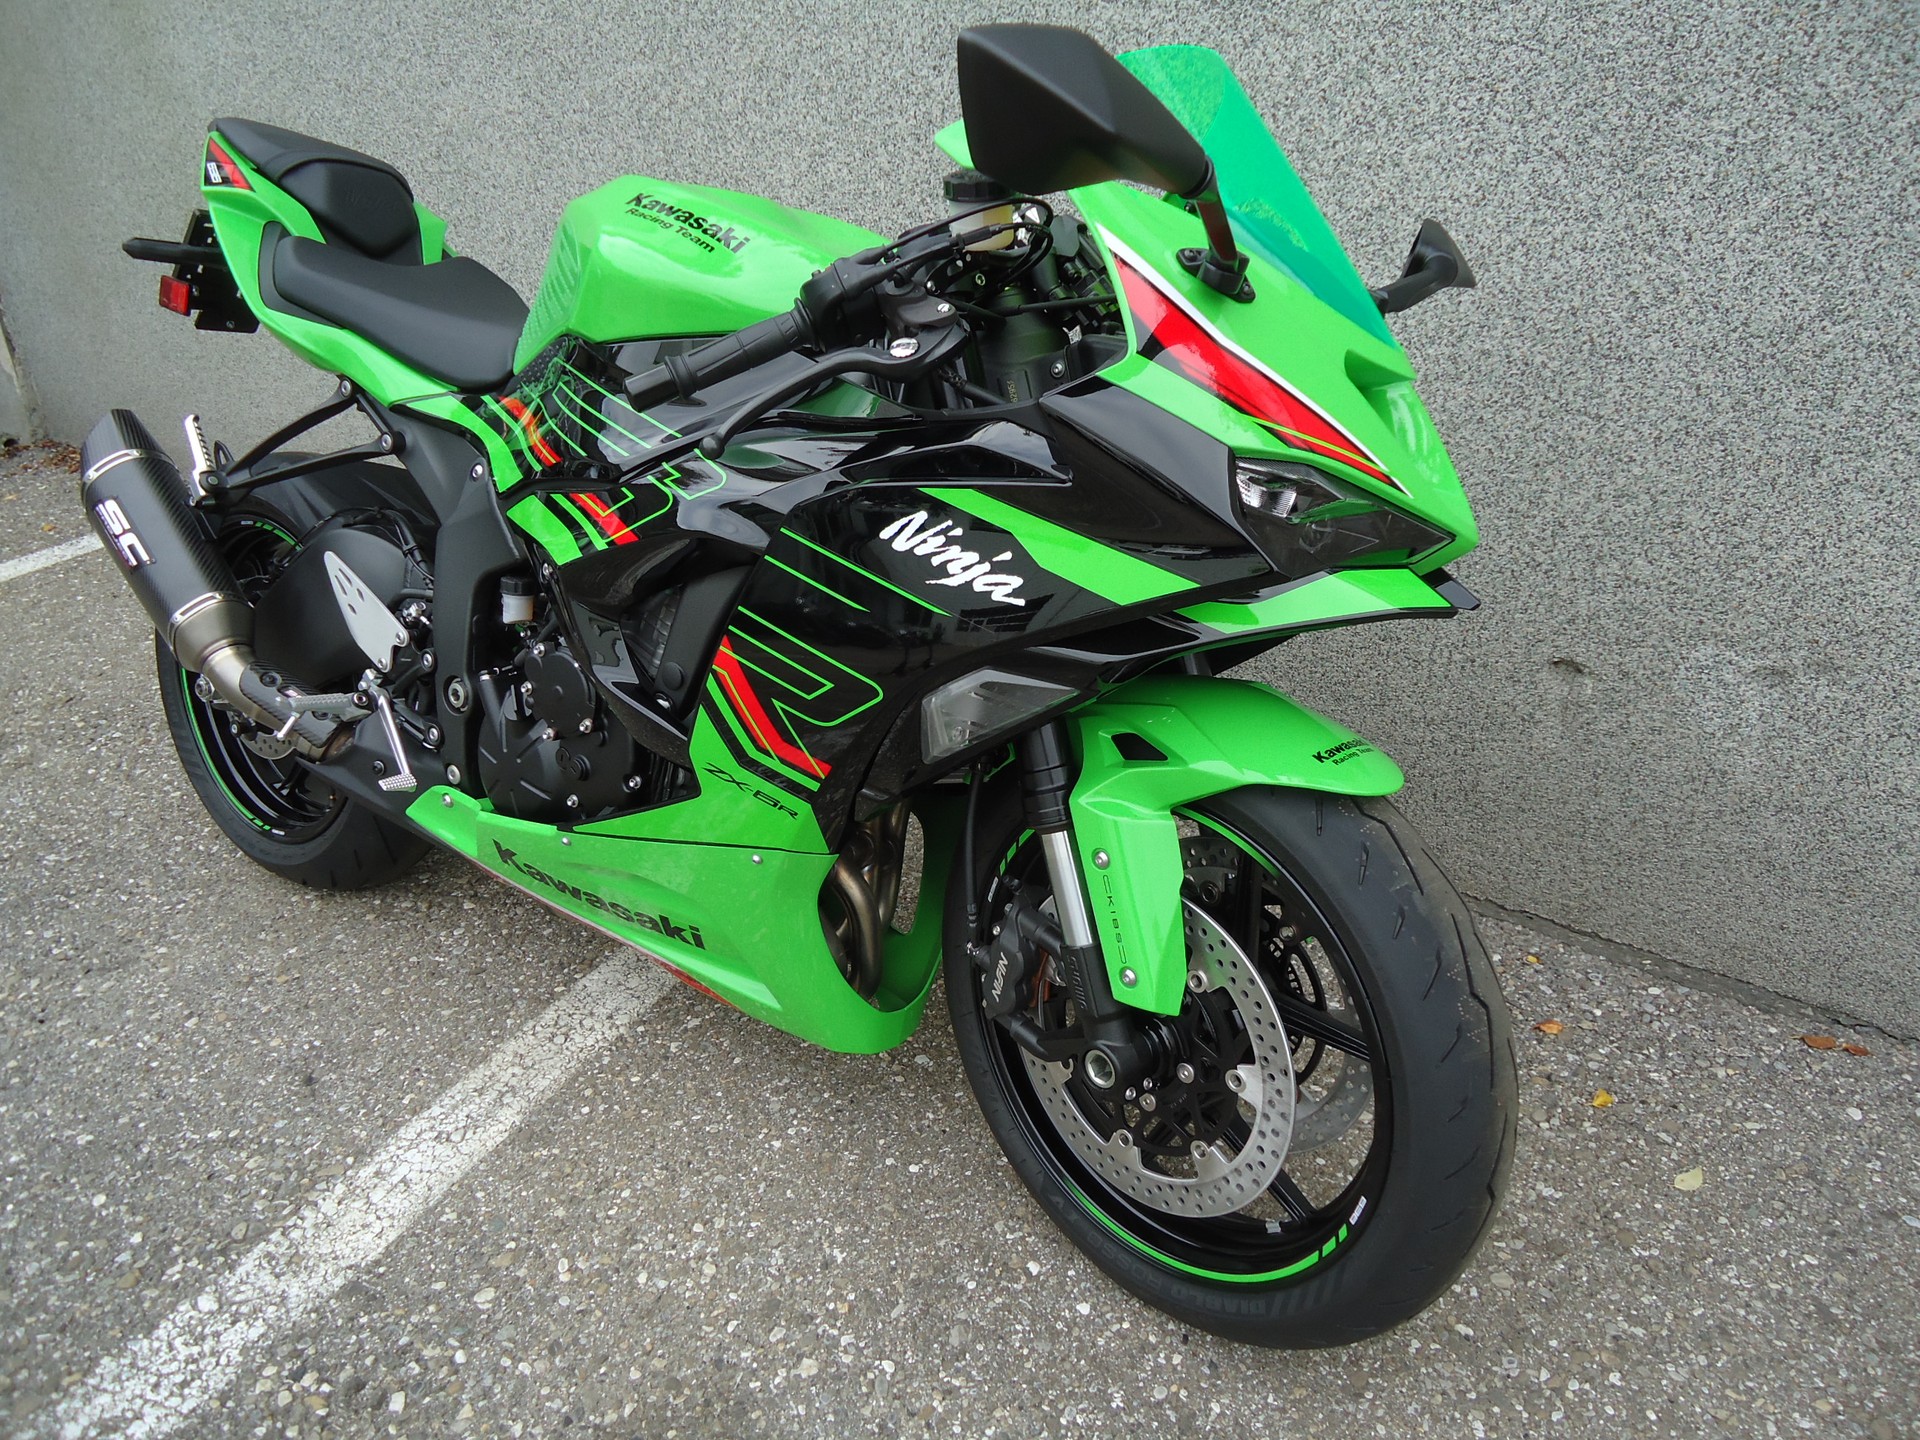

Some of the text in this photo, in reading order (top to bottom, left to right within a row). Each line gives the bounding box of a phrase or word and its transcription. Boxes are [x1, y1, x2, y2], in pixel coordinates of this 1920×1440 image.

[625, 192, 750, 254] Kawasaki
[625, 207, 716, 253] Racing Team
[879, 510, 1026, 607] Ninja
[1331, 750, 1360, 766] Racing
[702, 761, 799, 821] ZX-6R
[492, 838, 706, 951] Kawasaki
